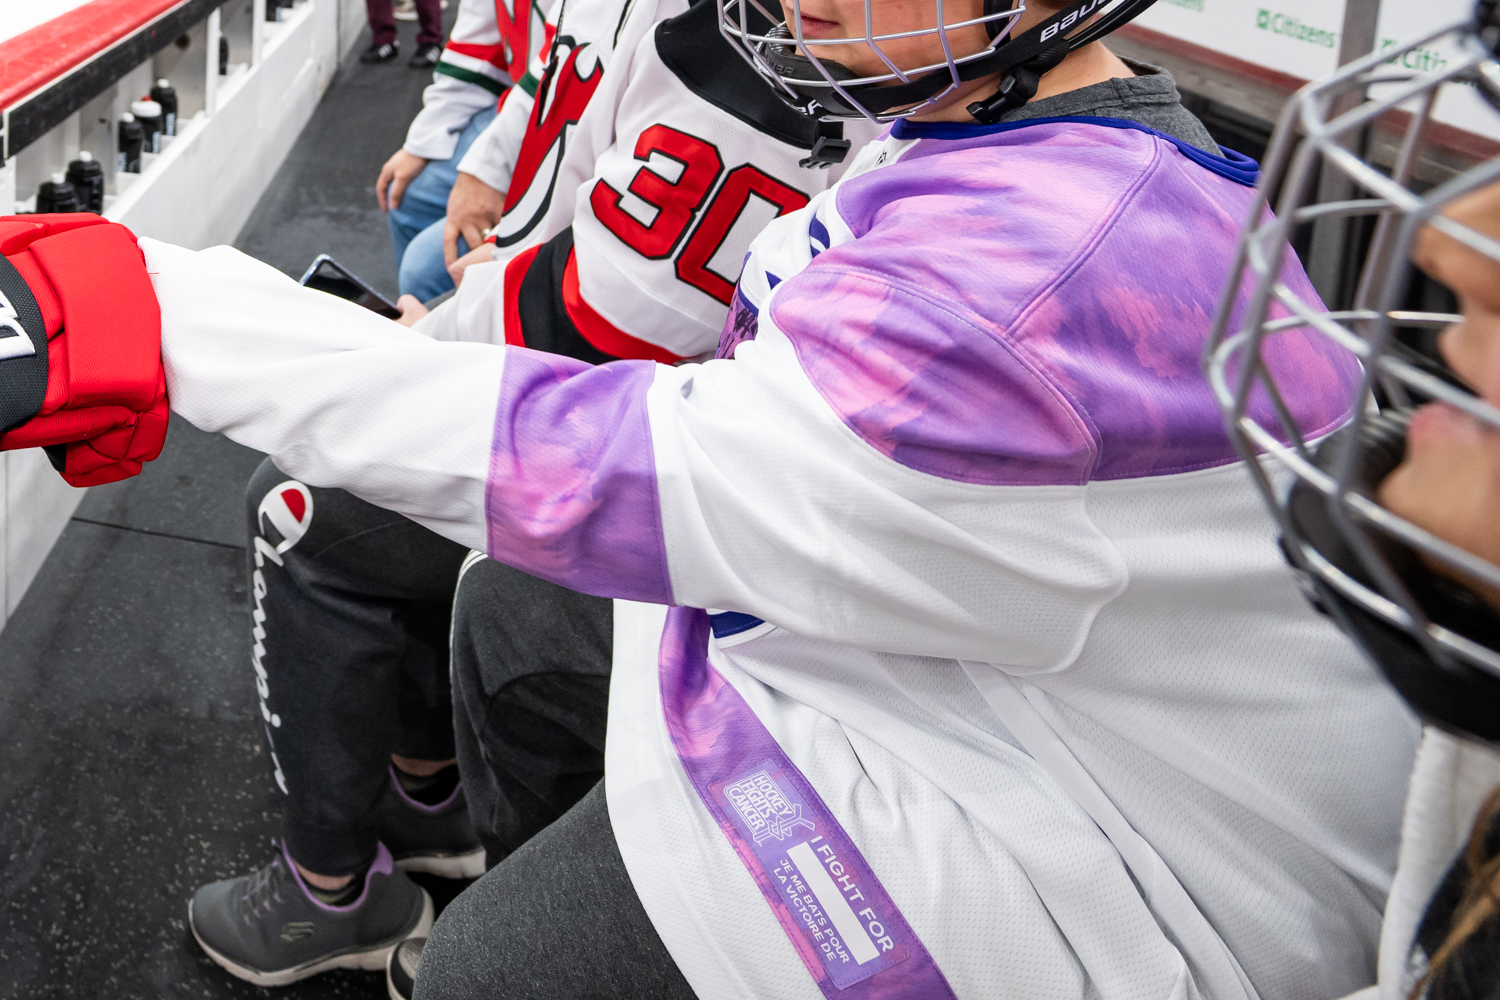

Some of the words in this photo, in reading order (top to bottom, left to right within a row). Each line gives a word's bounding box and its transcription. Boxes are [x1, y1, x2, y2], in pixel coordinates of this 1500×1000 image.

[1271, 12, 1336, 48] Citizens
[590, 122, 812, 308] 30
[729, 787, 766, 831] CANCER
[740, 780, 776, 819] FIGHTS
[753, 775, 793, 816] HOCKEY
[773, 867, 788, 885] LA
[786, 884, 825, 942] VICTOIRE
[820, 942, 837, 962] DE
[779, 859, 794, 873] JE
[790, 874, 807, 894] ME
[803, 894, 827, 927] BATS
[824, 928, 850, 964] POUR
[810, 835, 823, 844] I
[817, 844, 865, 902] FIGHT
[858, 907, 894, 953] FOR
